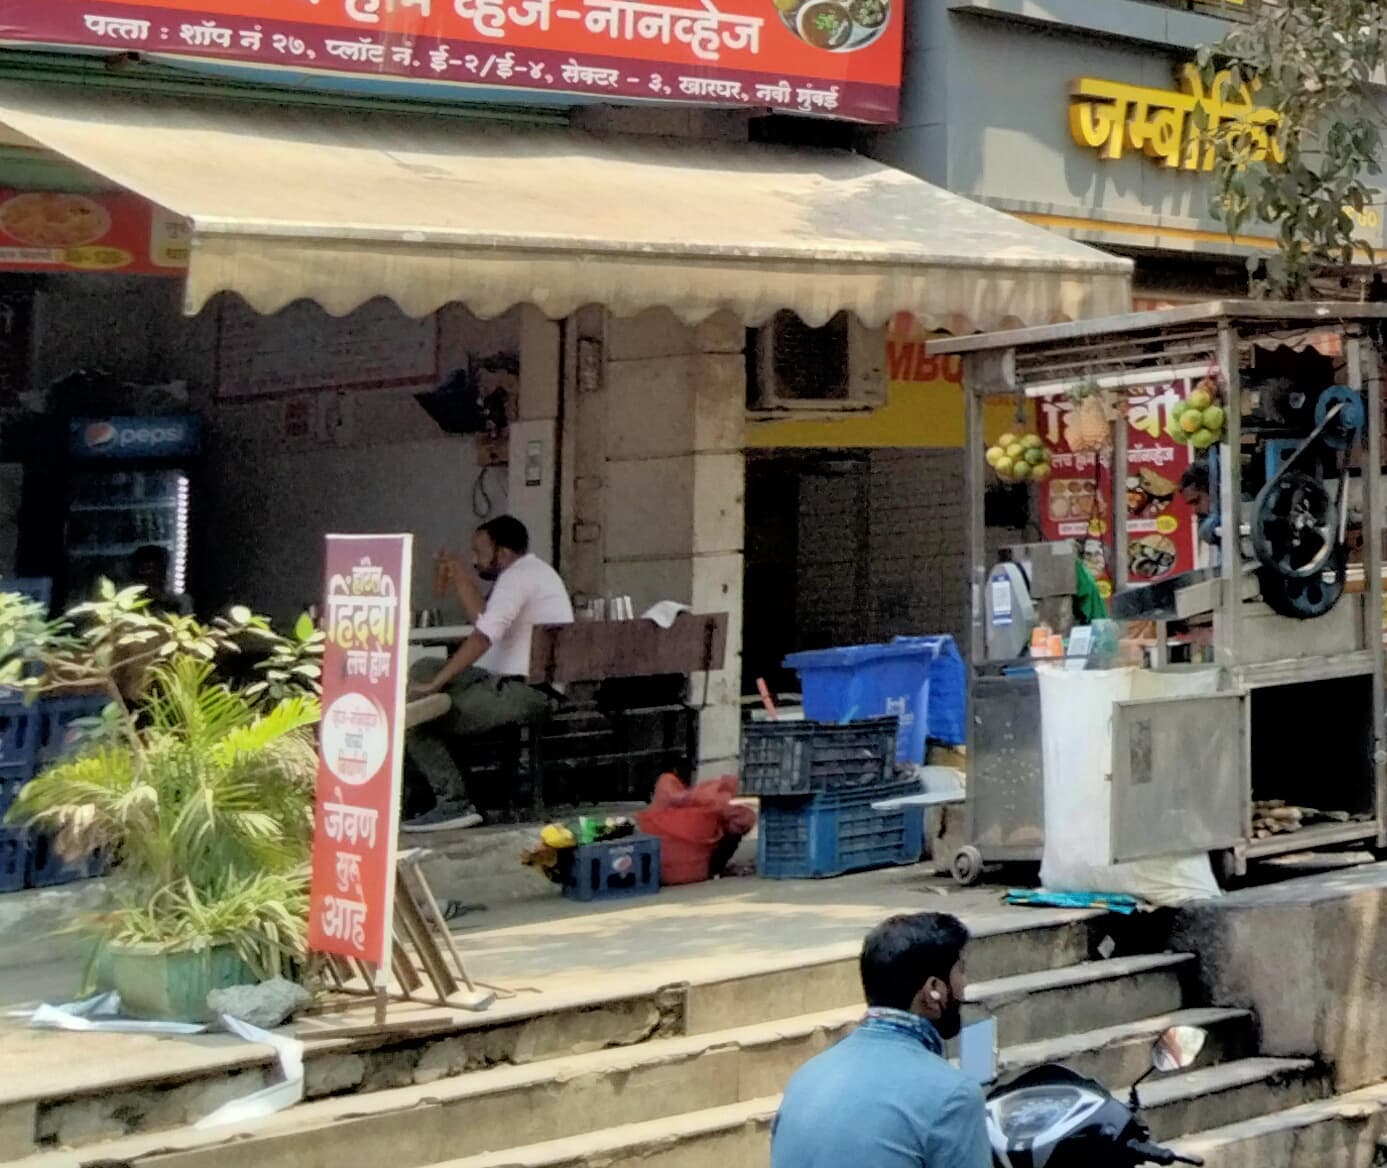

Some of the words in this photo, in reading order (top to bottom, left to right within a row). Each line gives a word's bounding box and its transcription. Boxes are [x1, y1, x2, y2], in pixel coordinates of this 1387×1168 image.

[178, 20, 233, 48] शॉप
[239, 24, 262, 51] नं
[271, 34, 316, 61] २७,
[325, 37, 385, 63] प्लॉट
[561, 58, 619, 87] सेक्टर
[679, 75, 750, 102] खारघर,
[755, 81, 790, 105] नवी
[796, 82, 840, 113] मुंबई
[327, 574, 398, 650] हिंदवी
[324, 786, 378, 849] जेवण
[321, 884, 367, 951] आहे
